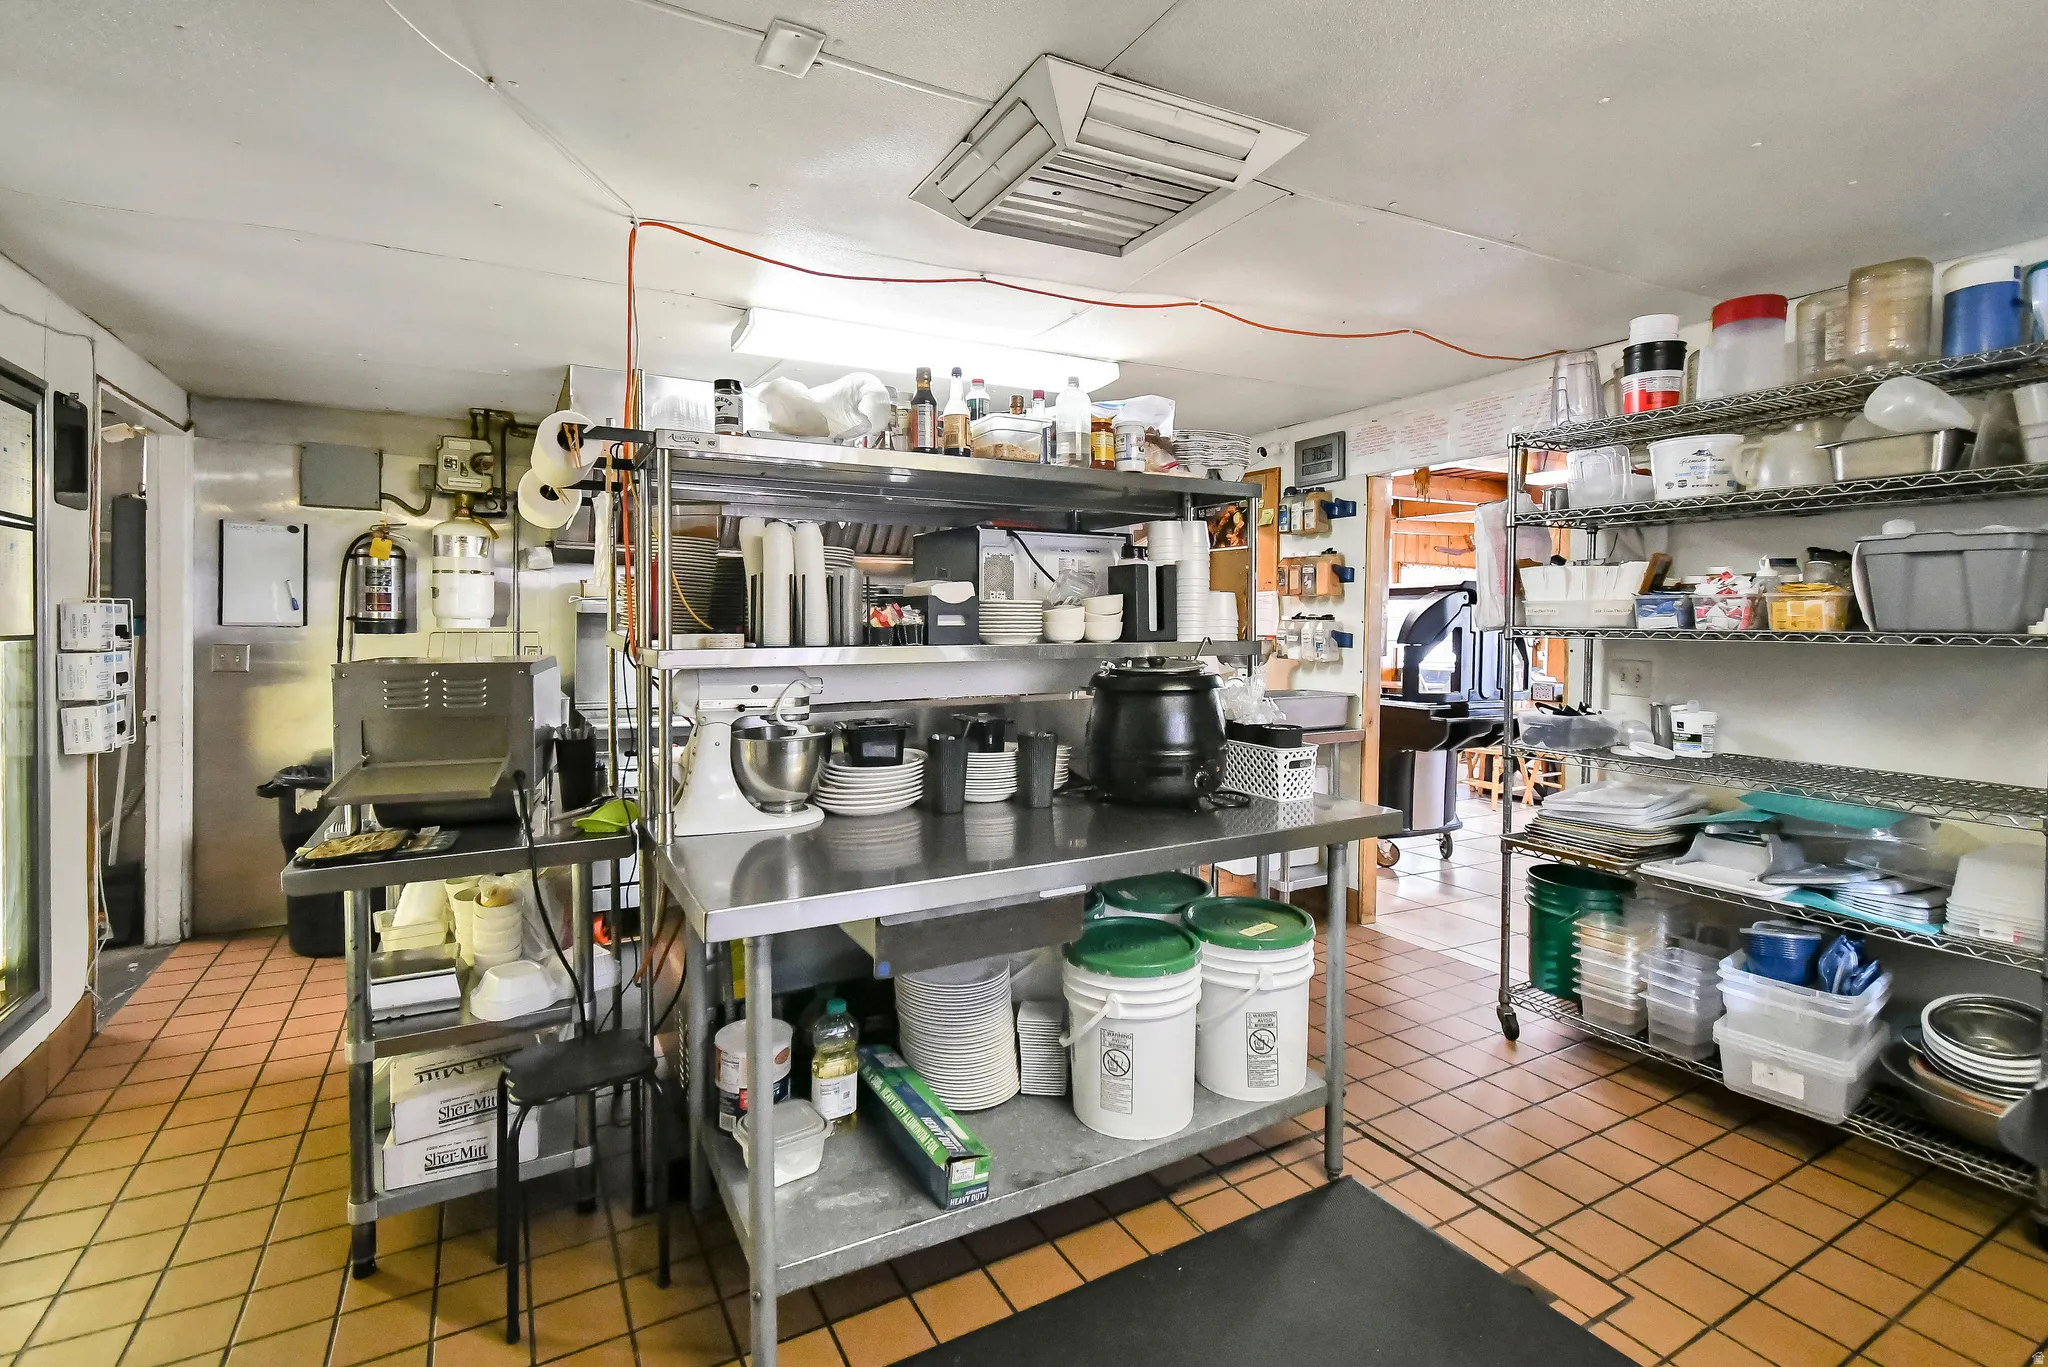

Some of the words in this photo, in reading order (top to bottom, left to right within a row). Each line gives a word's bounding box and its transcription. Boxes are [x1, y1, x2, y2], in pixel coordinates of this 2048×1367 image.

[438, 1095, 498, 1121] Sher-Mit
[880, 1087, 897, 1105] HEAVY
[892, 1100, 907, 1116] DUTY
[902, 1110, 931, 1144] ALUMINUM
[925, 1138, 940, 1155] FOIL
[424, 1144, 488, 1168] Sher-Mitt
[950, 1195, 970, 1206] HEAVY
[971, 1191, 987, 1202] DUTY
